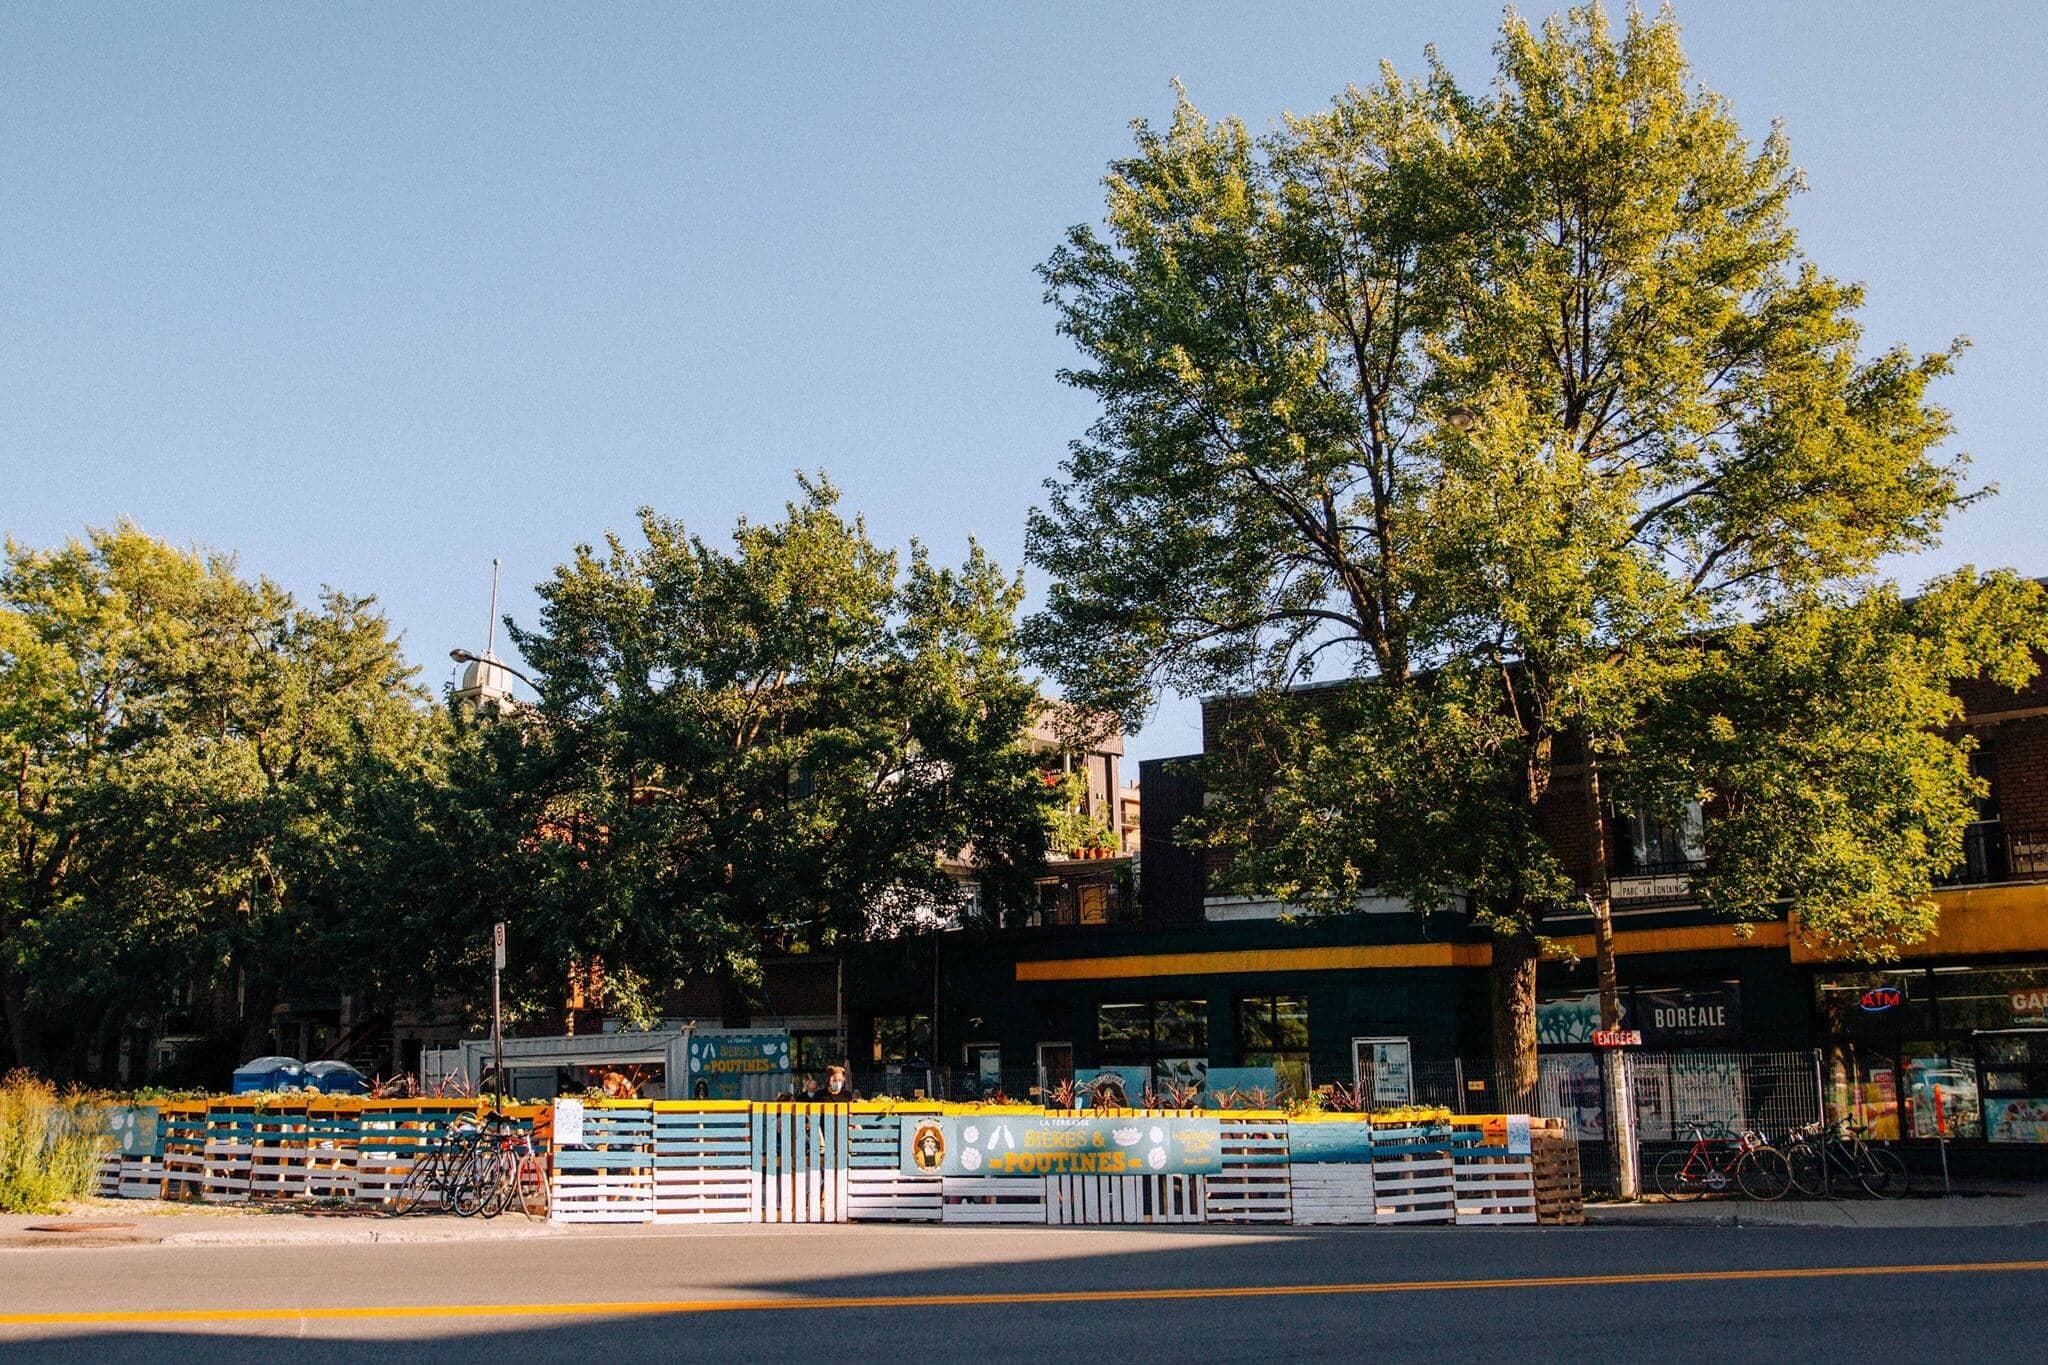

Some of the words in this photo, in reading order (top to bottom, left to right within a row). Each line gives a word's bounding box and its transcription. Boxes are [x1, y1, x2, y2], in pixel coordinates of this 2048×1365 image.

[1653, 884, 1681, 896] FONTAIN
[1861, 991, 1900, 1007] ATM
[1655, 1005, 1726, 1028] BORÉALE
[1598, 1030, 1633, 1046] ENTRÉE
[710, 1059, 769, 1073] POUTINES
[1039, 1119, 1050, 1127] LA
[1052, 1119, 1090, 1127] TERRASSE
[1023, 1128, 1088, 1149] BIÈRES
[1092, 1130, 1106, 1149] &
[1003, 1151, 1126, 1173] POUTINES
